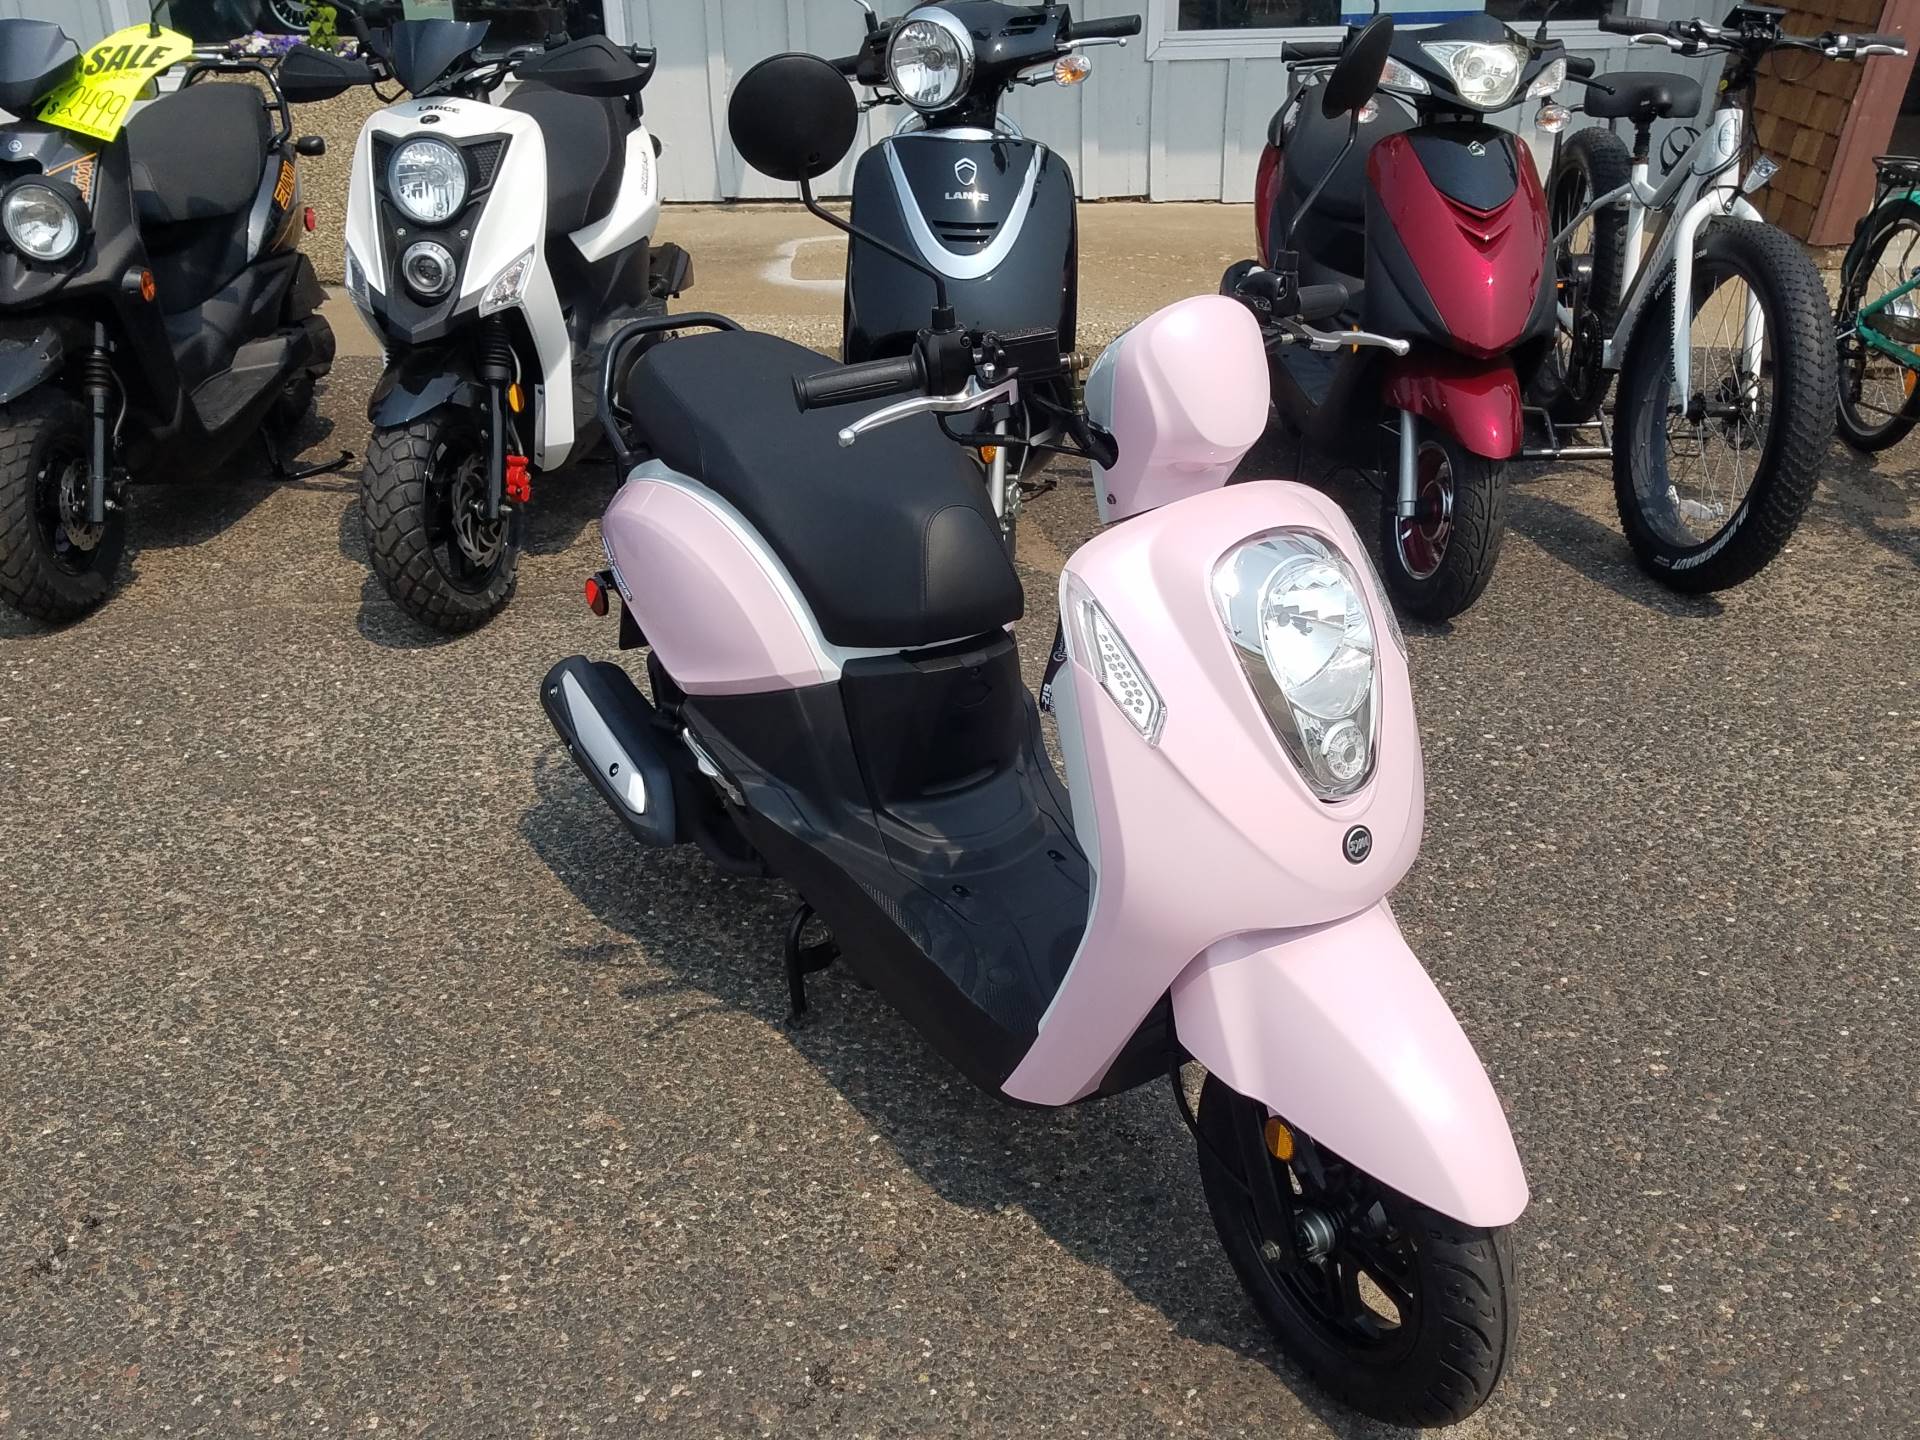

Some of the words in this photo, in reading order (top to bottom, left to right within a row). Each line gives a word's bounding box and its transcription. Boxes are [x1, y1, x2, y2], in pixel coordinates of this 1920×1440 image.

[85, 44, 173, 75] SALE
[417, 105, 460, 114] LANCE
[1350, 836, 1369, 854] SYM
